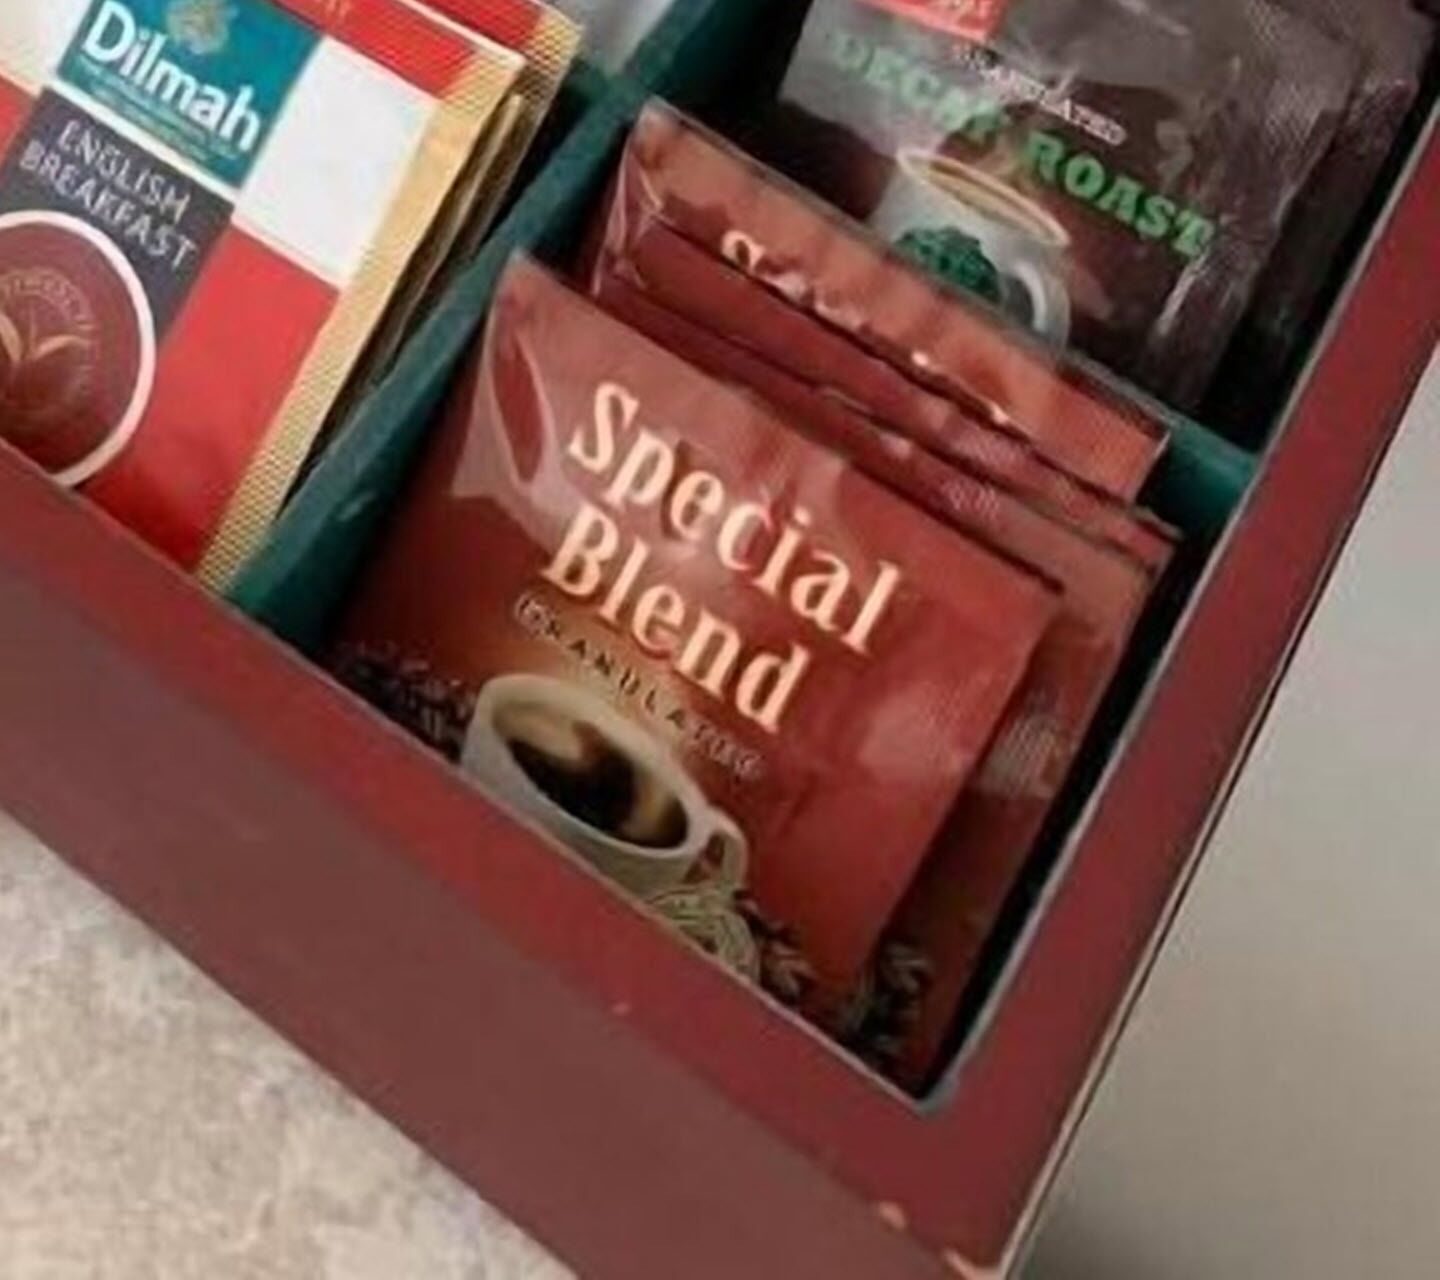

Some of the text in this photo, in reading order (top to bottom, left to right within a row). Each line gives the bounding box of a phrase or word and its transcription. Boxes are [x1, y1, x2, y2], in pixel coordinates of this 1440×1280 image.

[18, 144, 198, 272] BREAKFAST
[60, 118, 192, 221] ENGLISH
[1020, 128, 1216, 262] ROAST
[568, 380, 901, 655] Special
[542, 504, 811, 733] Blend
